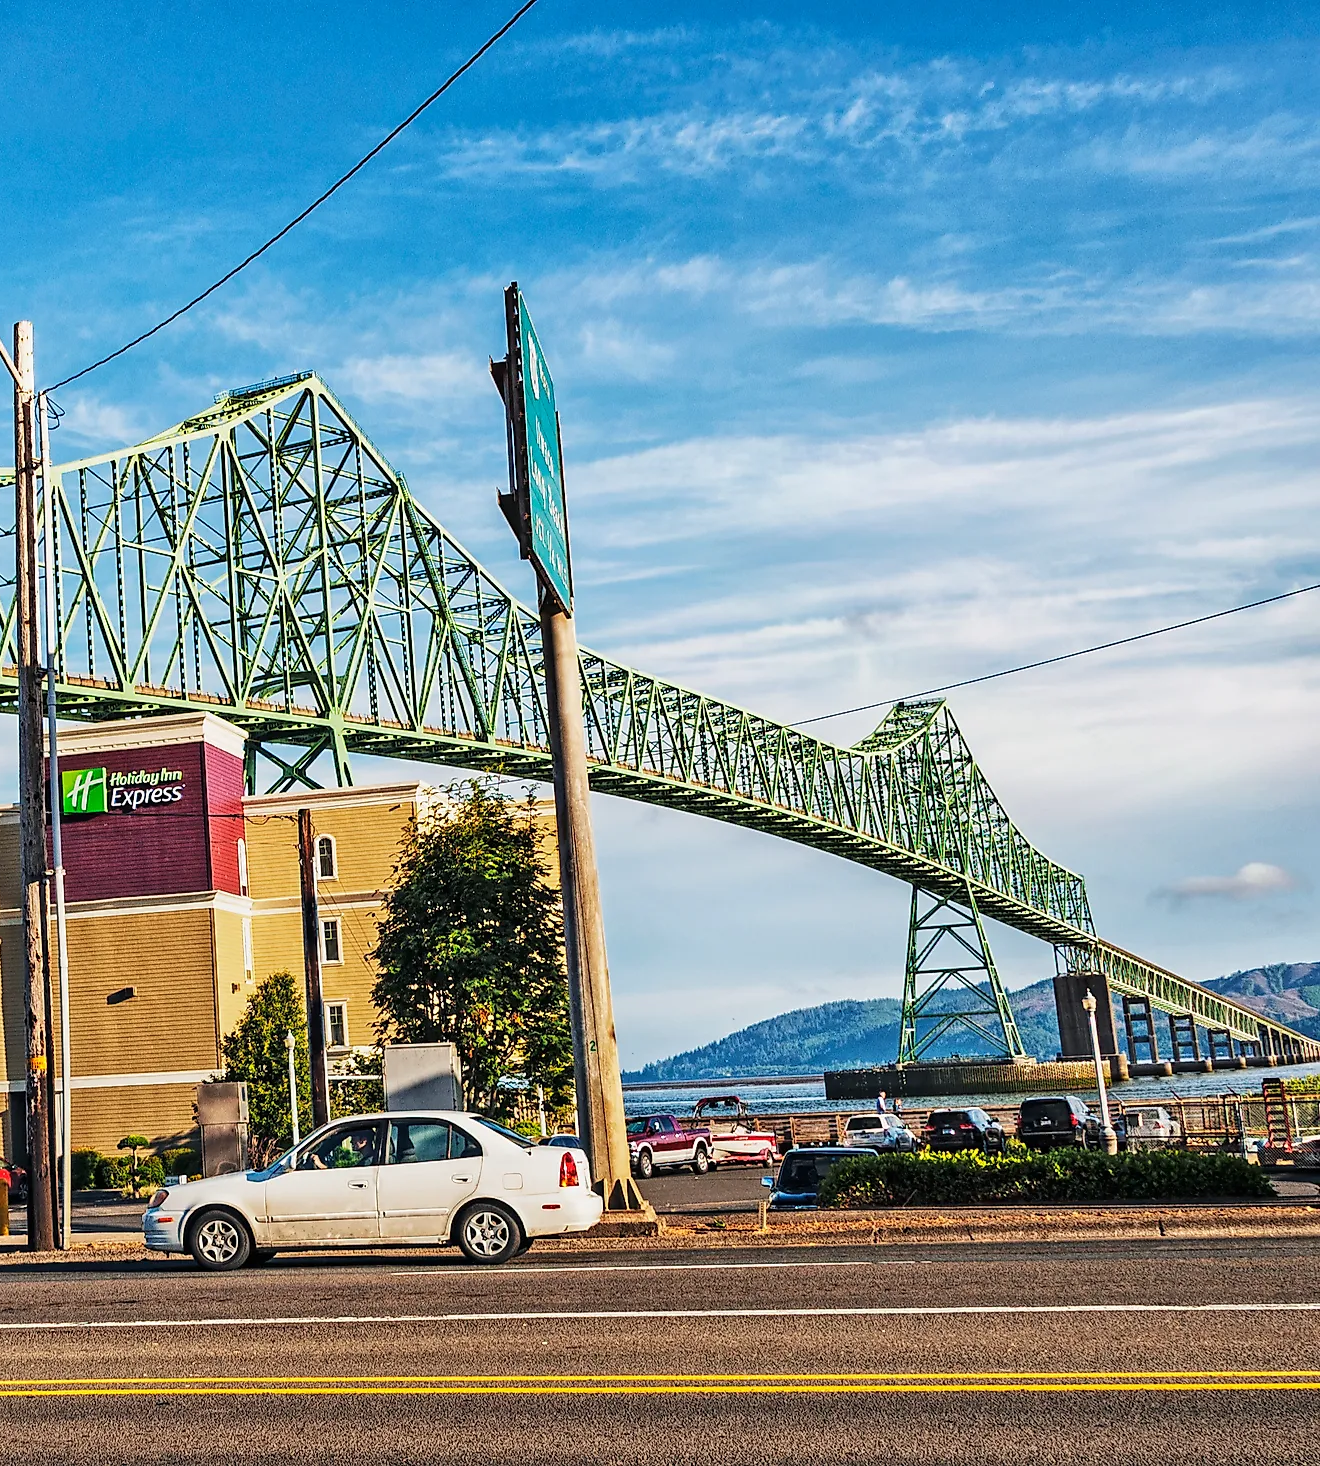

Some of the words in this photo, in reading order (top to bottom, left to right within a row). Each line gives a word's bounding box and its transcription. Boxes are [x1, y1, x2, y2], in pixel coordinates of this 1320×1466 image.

[109, 770, 160, 786] Holiday
[160, 767, 183, 781] Inn
[110, 786, 183, 810] Express
[589, 1040, 597, 1052] 2
